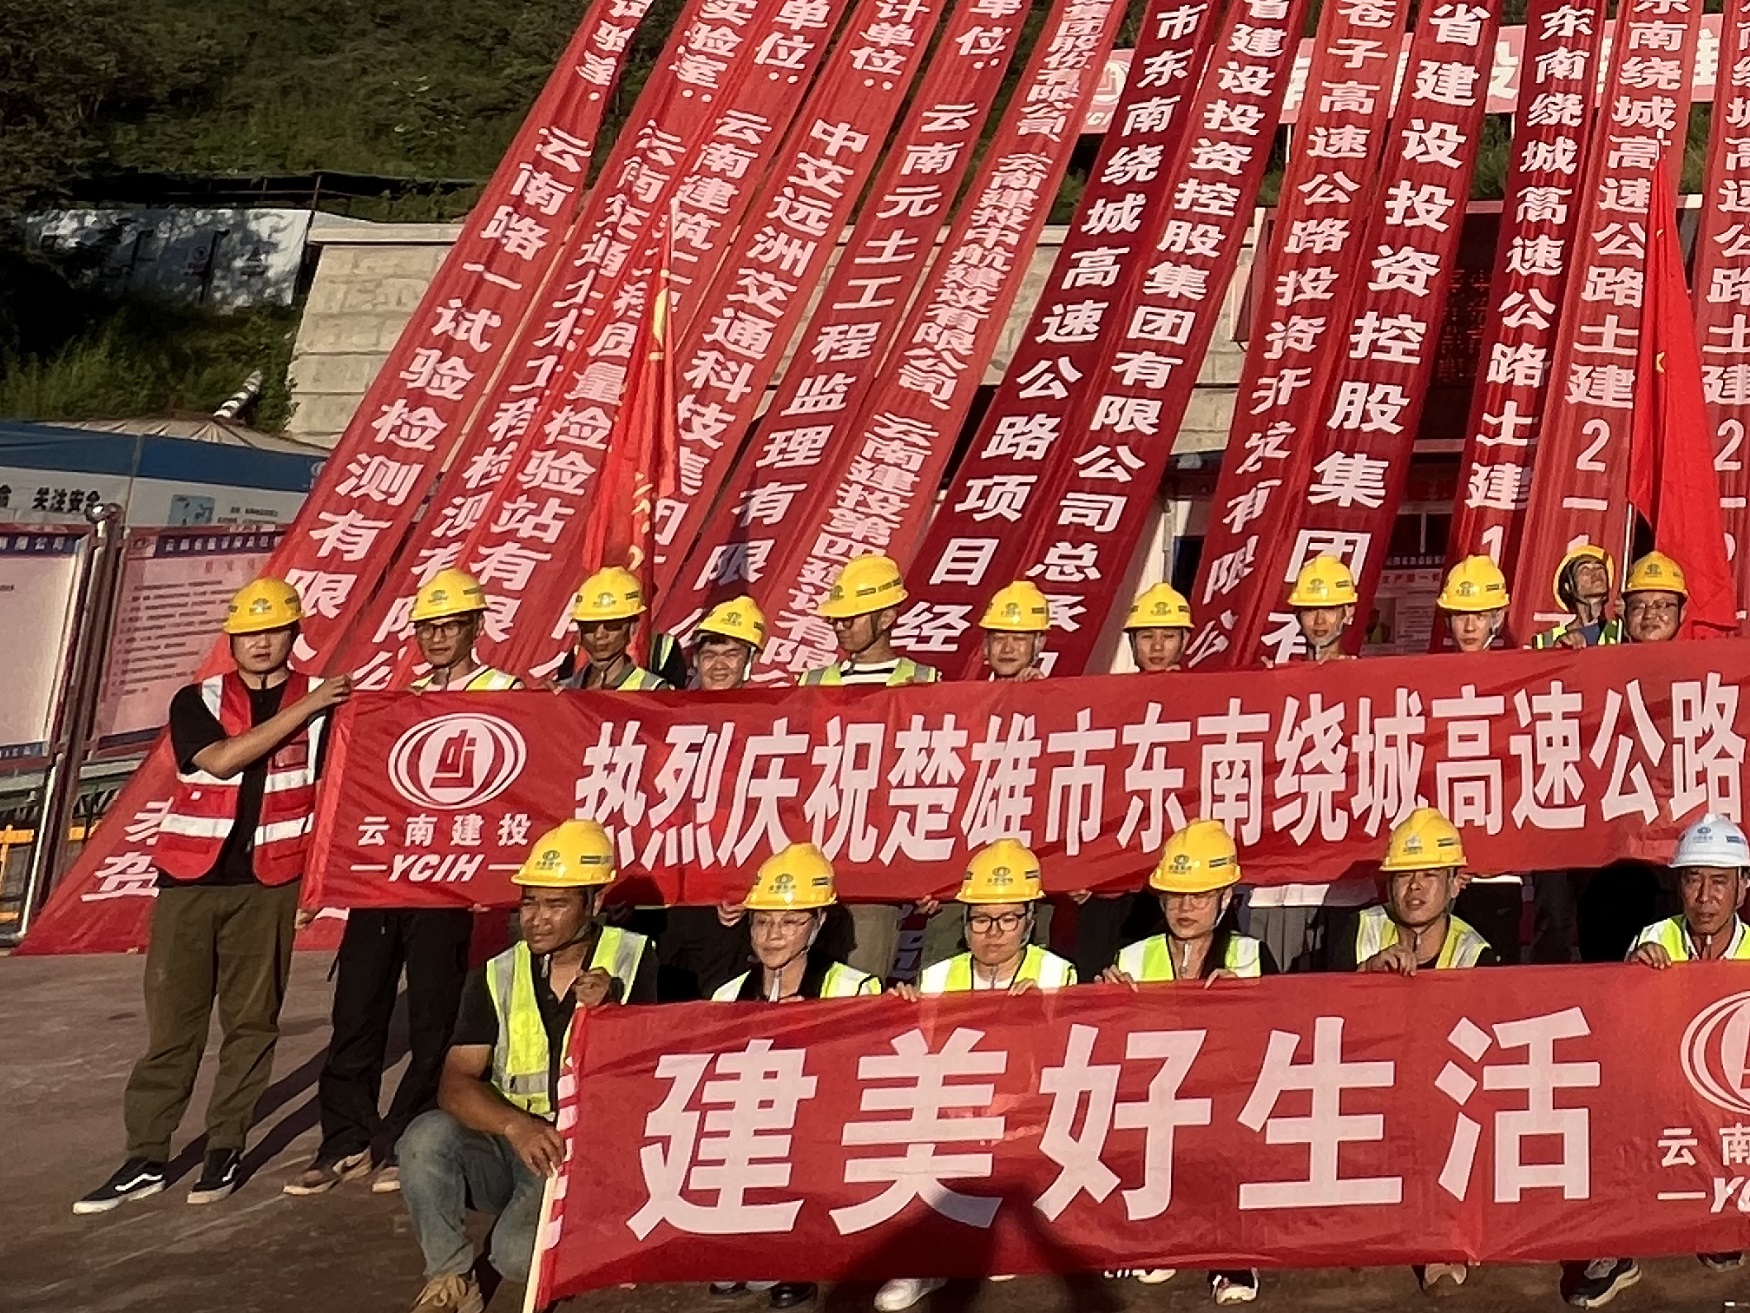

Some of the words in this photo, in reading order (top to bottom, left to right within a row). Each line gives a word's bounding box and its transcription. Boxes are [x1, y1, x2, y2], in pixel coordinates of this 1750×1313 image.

[357, 811, 532, 849] 云南建投
[390, 853, 479, 883] YCIH
[628, 1003, 1602, 1241] 建美好生活
